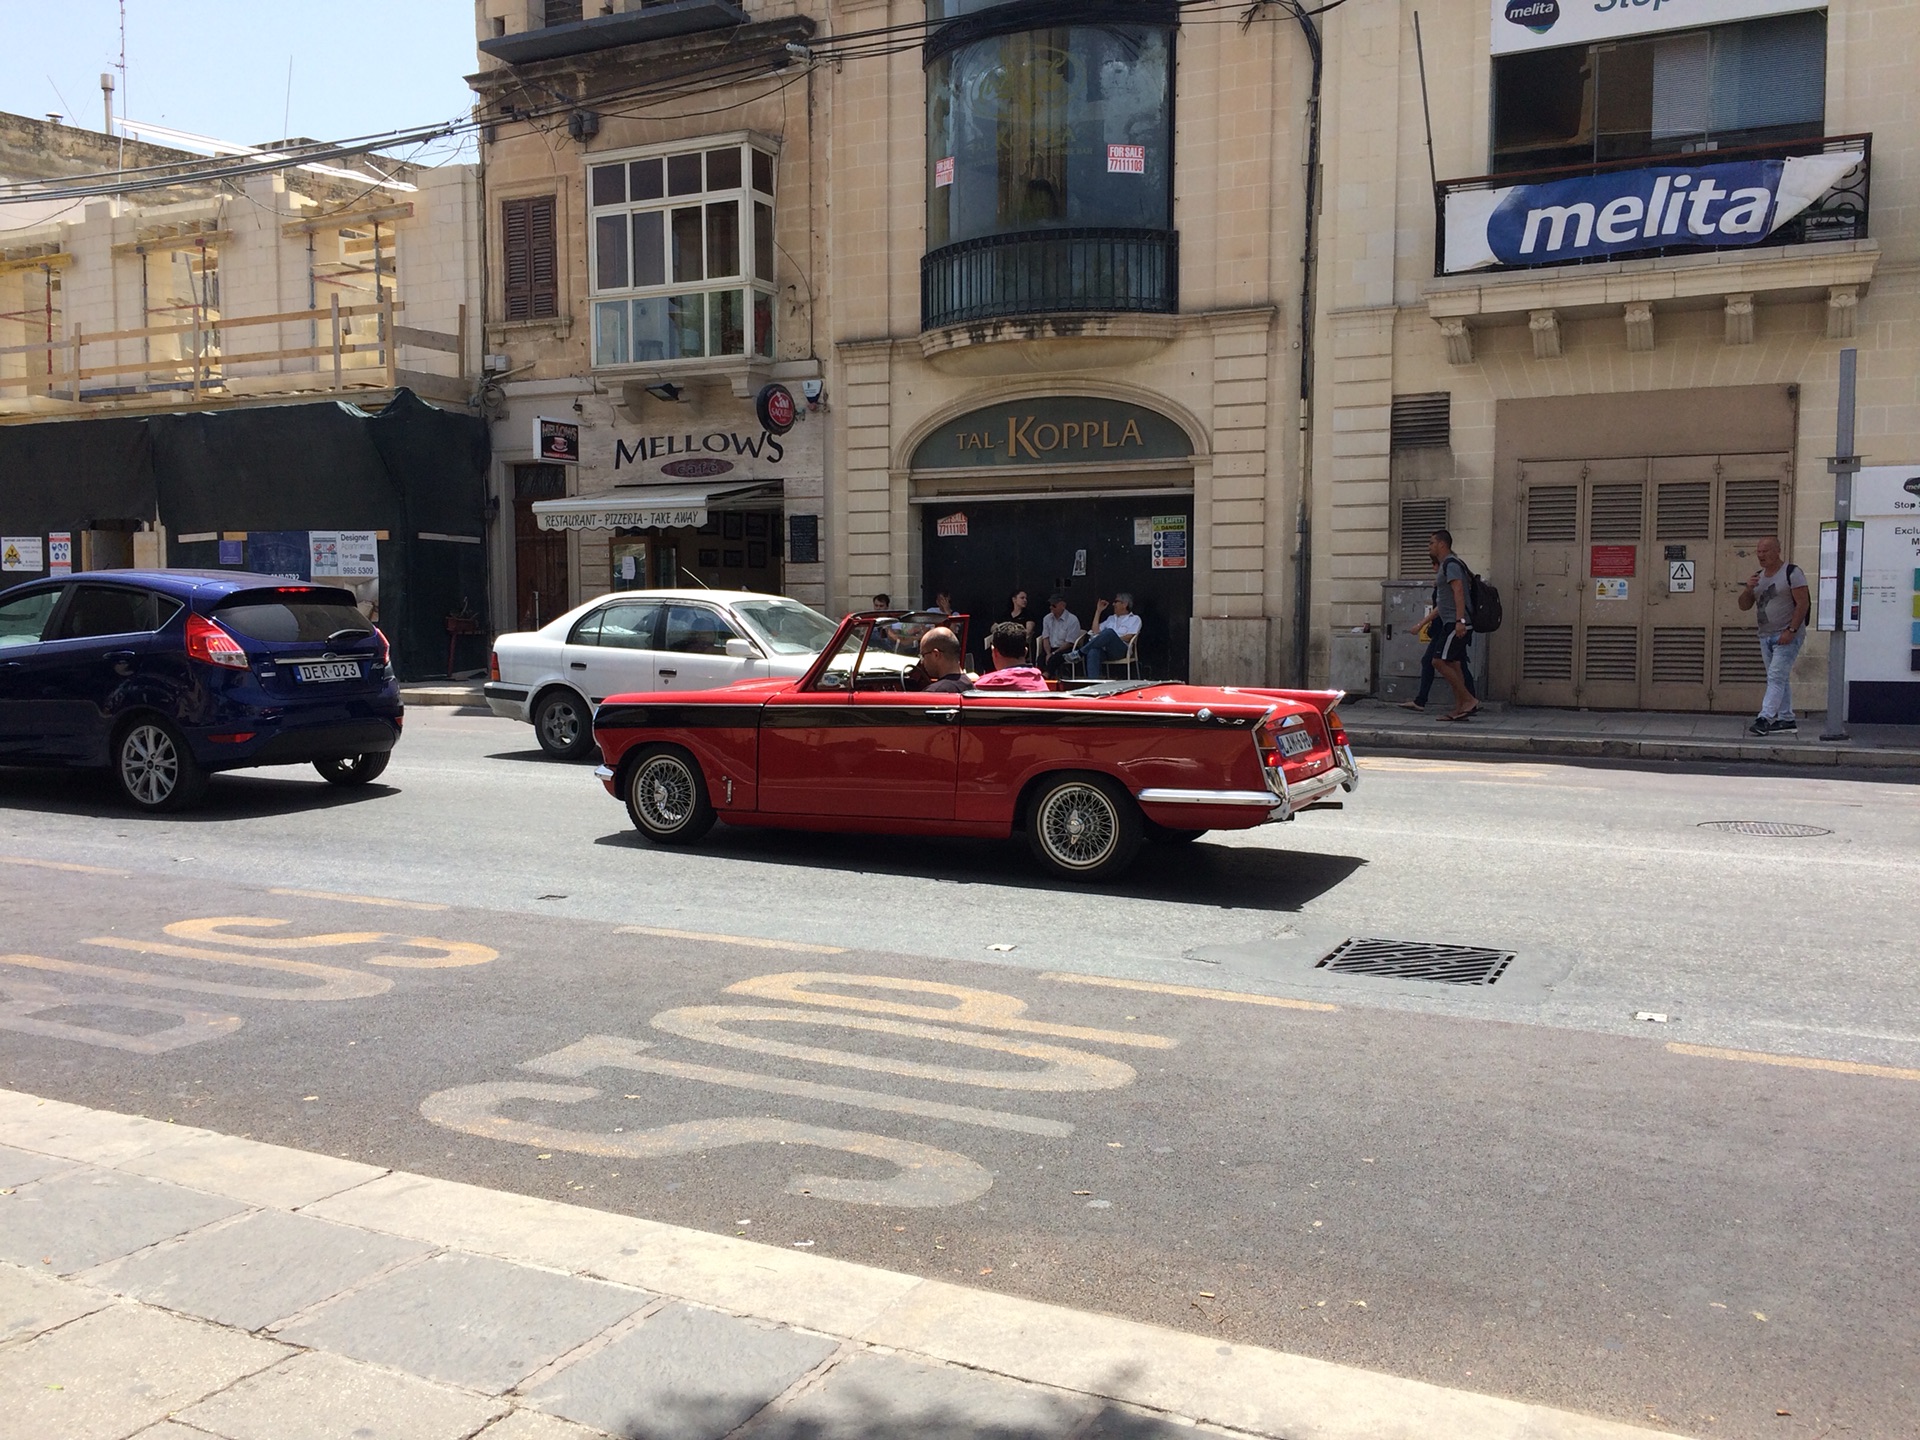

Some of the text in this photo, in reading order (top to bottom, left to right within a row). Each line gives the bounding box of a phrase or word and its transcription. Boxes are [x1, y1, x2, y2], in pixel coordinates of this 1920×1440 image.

[1509, 1, 1554, 19] melita
[1109, 147, 1143, 159] FOR SALE
[1109, 158, 1142, 172] 77111103
[1519, 174, 1771, 254] melita
[614, 431, 784, 470] MELLOWS
[677, 459, 718, 474] café
[1894, 501, 1916, 510] Stop
[545, 514, 597, 526] RESTAURANT
[604, 512, 644, 525] PIZZERIA
[650, 511, 672, 524] TAKE
[674, 511, 698, 524] AWAY
[341, 533, 369, 542] Designer
[0, 916, 500, 1055] BUS
[419, 971, 1180, 1208] STOP
